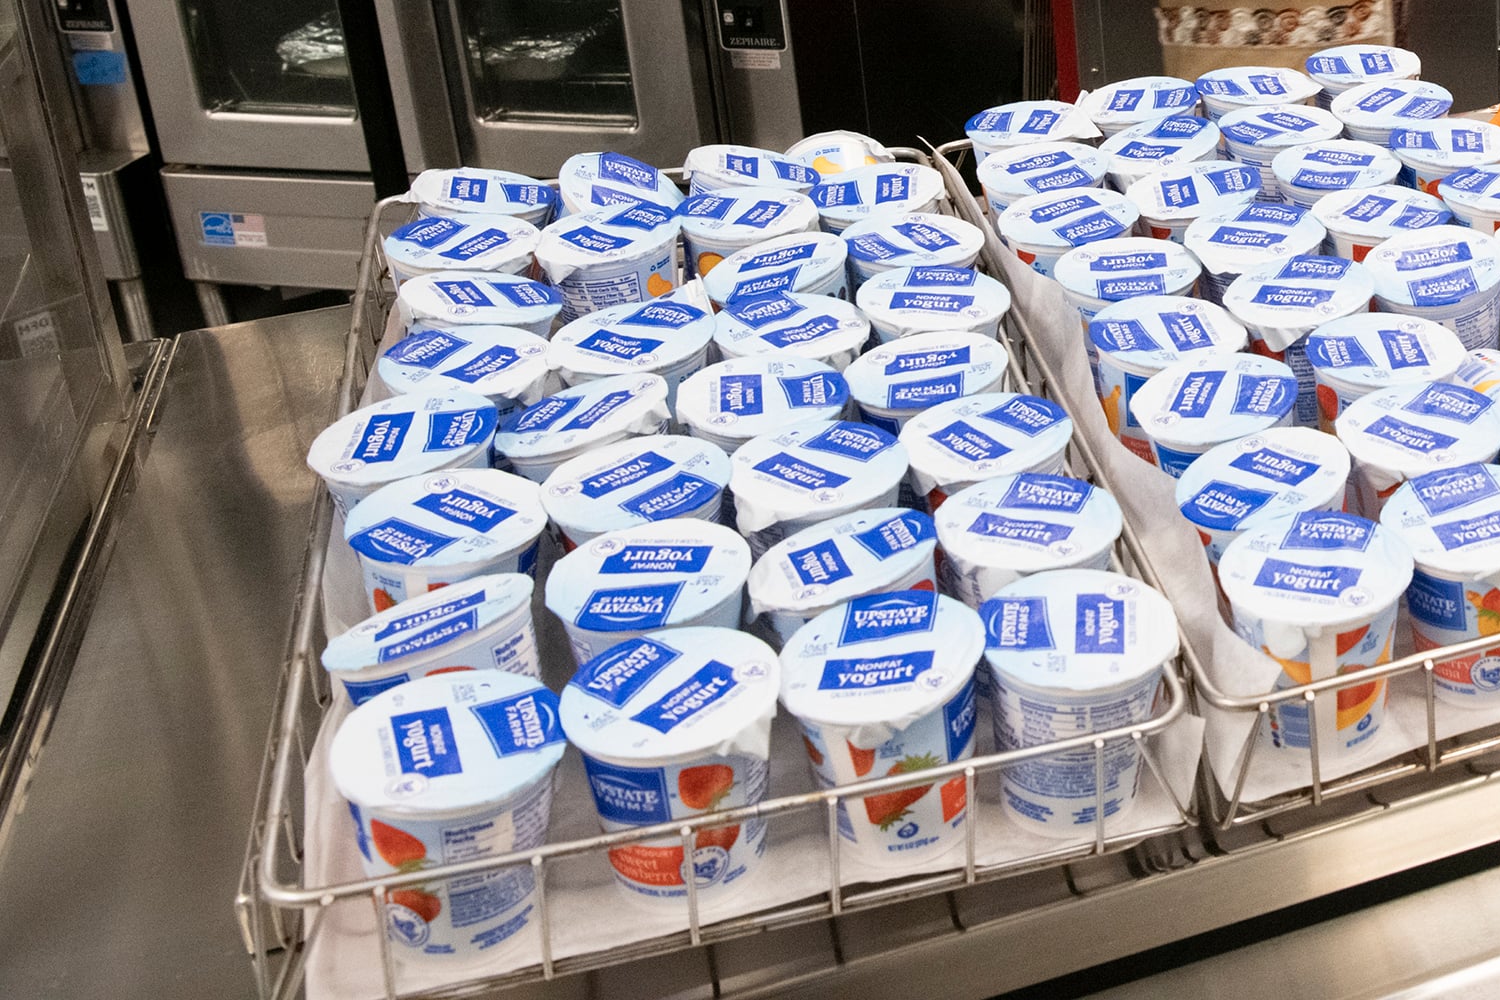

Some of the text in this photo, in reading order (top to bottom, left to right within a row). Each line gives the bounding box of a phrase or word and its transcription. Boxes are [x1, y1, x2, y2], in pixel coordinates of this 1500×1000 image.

[729, 37, 777, 47] ZEPHAIRE
[1128, 147, 1165, 158] yogurt
[605, 161, 655, 181] UPSTATE
[1035, 198, 1083, 218] yogurt
[461, 233, 504, 255] yogurt
[575, 231, 614, 250] yogurt
[1222, 233, 1271, 245] yogurt
[1102, 253, 1155, 267] yogurt
[1405, 244, 1459, 264] yogurt
[903, 298, 961, 312] yogurt
[1264, 292, 1318, 304] yogurt
[781, 321, 832, 344] yogurt
[592, 338, 641, 356] yogurt
[728, 382, 744, 412] yogurt
[1180, 375, 1201, 411] yogurt
[1426, 392, 1482, 414] UPSTATE
[1009, 399, 1055, 427] UPSTATE
[362, 420, 391, 458] yogurt
[451, 410, 476, 448] UPSTATE
[831, 428, 884, 450] UPSTATE
[1381, 426, 1436, 451] yogurt
[941, 432, 991, 461] yogurt
[590, 458, 651, 488] yogurt
[1252, 452, 1305, 473] yogurt
[772, 463, 826, 489] yogurt
[1017, 481, 1083, 504] UPSTATE
[441, 493, 500, 519] yogurt
[987, 522, 1053, 541] yogurt
[1299, 521, 1366, 538] UPSTATE
[368, 529, 428, 558] UPSTATE
[622, 549, 694, 562] yogurt
[801, 551, 831, 582] yogurt
[1272, 570, 1342, 591] yogurt
[589, 602, 664, 614] UPSTATE
[854, 606, 929, 626] UPSTATE
[1000, 602, 1020, 647] UPSTATE
[1098, 601, 1114, 645] yogurt
[588, 643, 658, 691] UPSTATE
[838, 664, 914, 687] yogurt
[660, 676, 728, 721] yogurt
[516, 696, 545, 748] UPSTATE
[401, 720, 434, 771] yogurt
